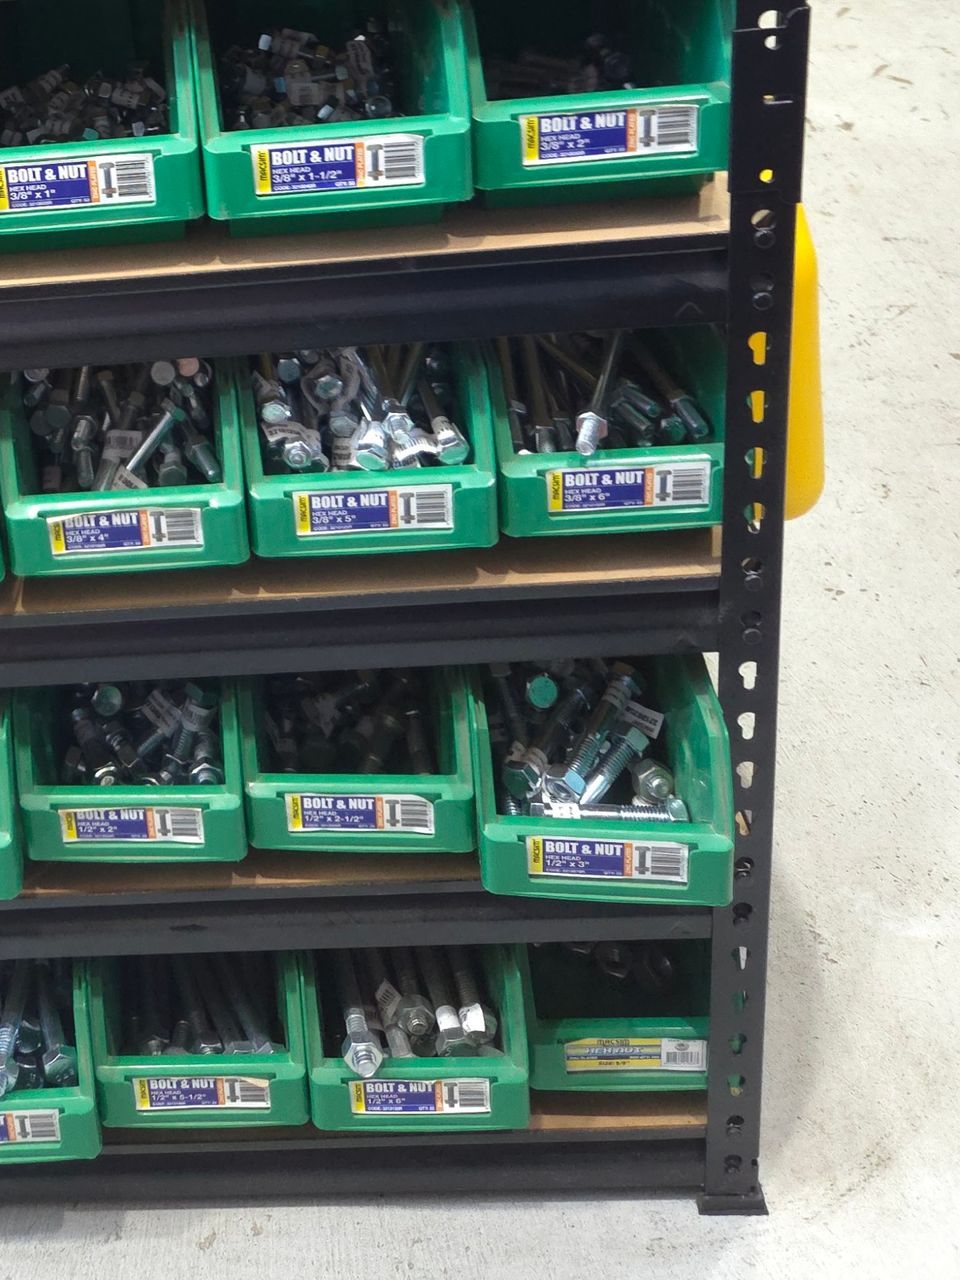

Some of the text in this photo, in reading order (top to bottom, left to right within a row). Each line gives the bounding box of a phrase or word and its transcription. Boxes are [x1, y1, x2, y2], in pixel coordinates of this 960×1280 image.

[540, 112, 626, 133] BOLT & NUT
[271, 146, 355, 165] BOLT & NUT
[7, 164, 87, 183] BOLT & NUT
[34, 190, 43, 198] x
[565, 471, 644, 487] BOLT & NUT
[311, 493, 388, 509] BOLT & NUT
[63, 512, 138, 527] BOLT & NUT
[335, 514, 343, 522] x
[303, 798, 374, 810] BOLT & NUT
[75, 808, 144, 820] BOLT & NUT
[545, 841, 623, 856] BOLT & NUT
[150, 1078, 214, 1088] BOLT & NUT
[366, 1082, 433, 1093] BOLT & NUT
